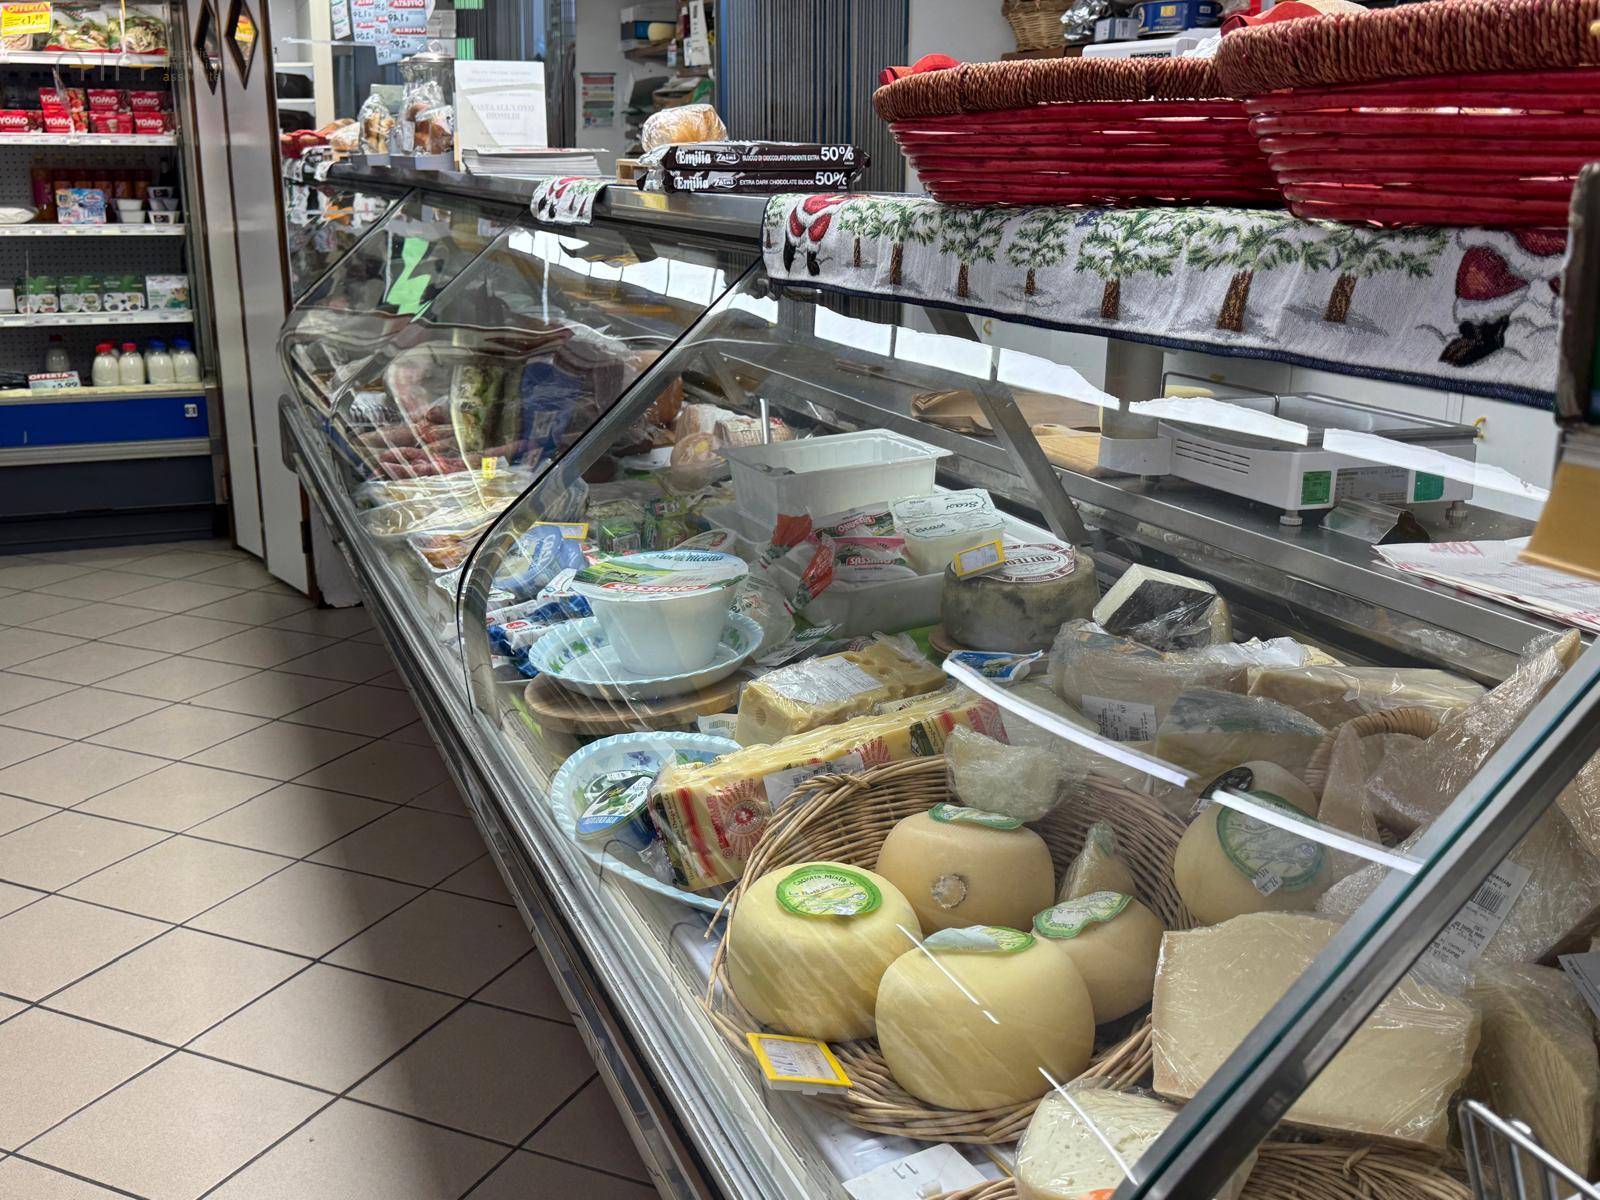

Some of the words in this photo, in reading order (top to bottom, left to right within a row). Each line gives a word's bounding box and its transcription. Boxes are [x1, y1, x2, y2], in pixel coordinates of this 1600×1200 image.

[89, 95, 118, 105] YOMO
[131, 97, 159, 106] YOMO
[135, 118, 163, 128] YOMO
[675, 150, 712, 167] Emilia
[820, 147, 854, 161] 50%
[674, 177, 710, 191] Emilia
[756, 178, 769, 186] DARK
[769, 178, 797, 186] CHOCOLATE
[797, 178, 814, 186] BLOCK
[815, 171, 848, 186] 50%
[28, 372, 68, 380] OFFERTA
